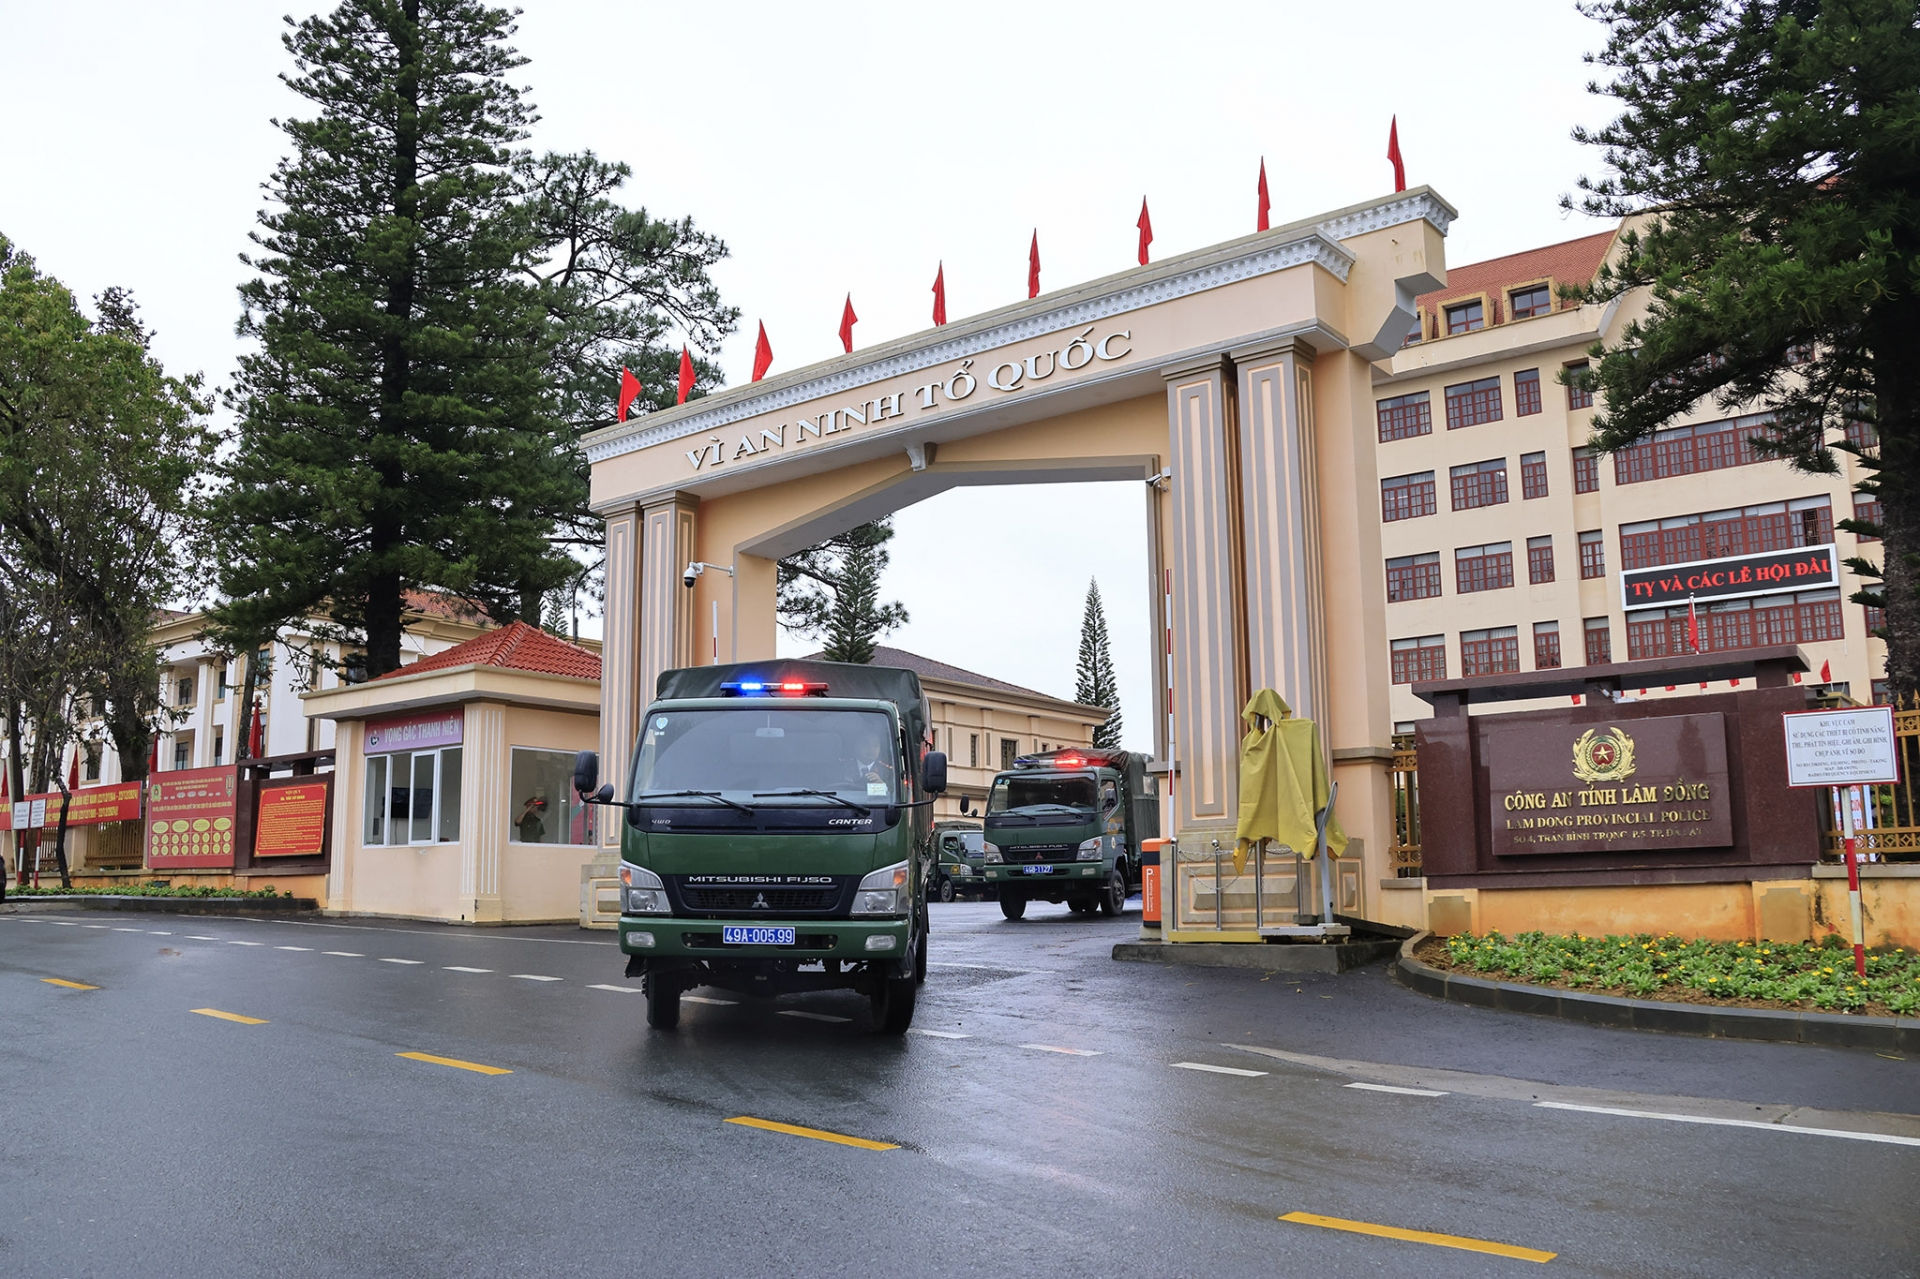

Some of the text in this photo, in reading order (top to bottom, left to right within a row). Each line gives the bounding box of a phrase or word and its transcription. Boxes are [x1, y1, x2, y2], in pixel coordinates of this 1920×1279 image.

[685, 326, 1132, 470] VÌ AN NINH TỔ QUỐC
[1659, 574, 1684, 592] VÀ
[1687, 570, 1725, 589] CÁC
[1728, 565, 1752, 584] LỄ
[1755, 563, 1791, 581] HỘI
[418, 721, 441, 739] THANH
[442, 715, 460, 736] NIÊN
[1505, 777, 1710, 811] CÔNG AN TỈNH LÂM ĐỒNG
[1507, 809, 1711, 829] LAM DONG PROVINCIAL POLICE
[1566, 831, 1590, 841] BÌNH
[725, 928, 793, 943] 49A-005.99
